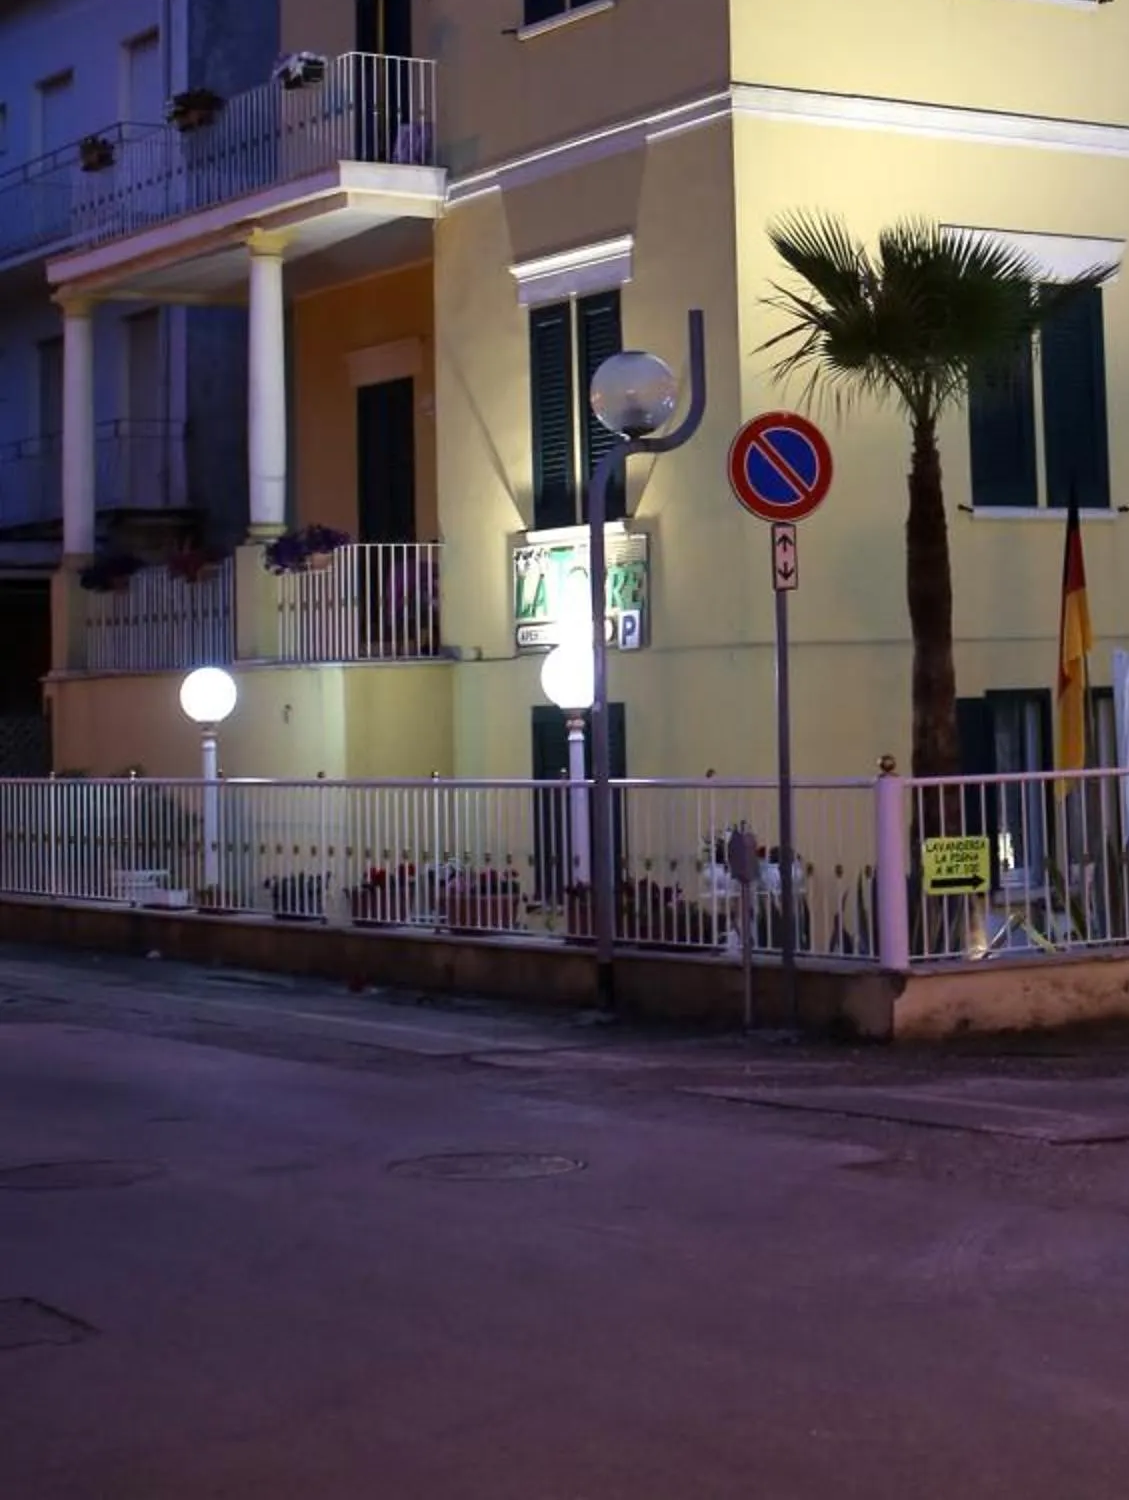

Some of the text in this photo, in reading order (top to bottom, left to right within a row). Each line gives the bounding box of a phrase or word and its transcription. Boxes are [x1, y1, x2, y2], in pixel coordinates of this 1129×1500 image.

[622, 615, 637, 646] P
[926, 840, 985, 852] LAVANDERIA
[935, 854, 946, 864] LA
